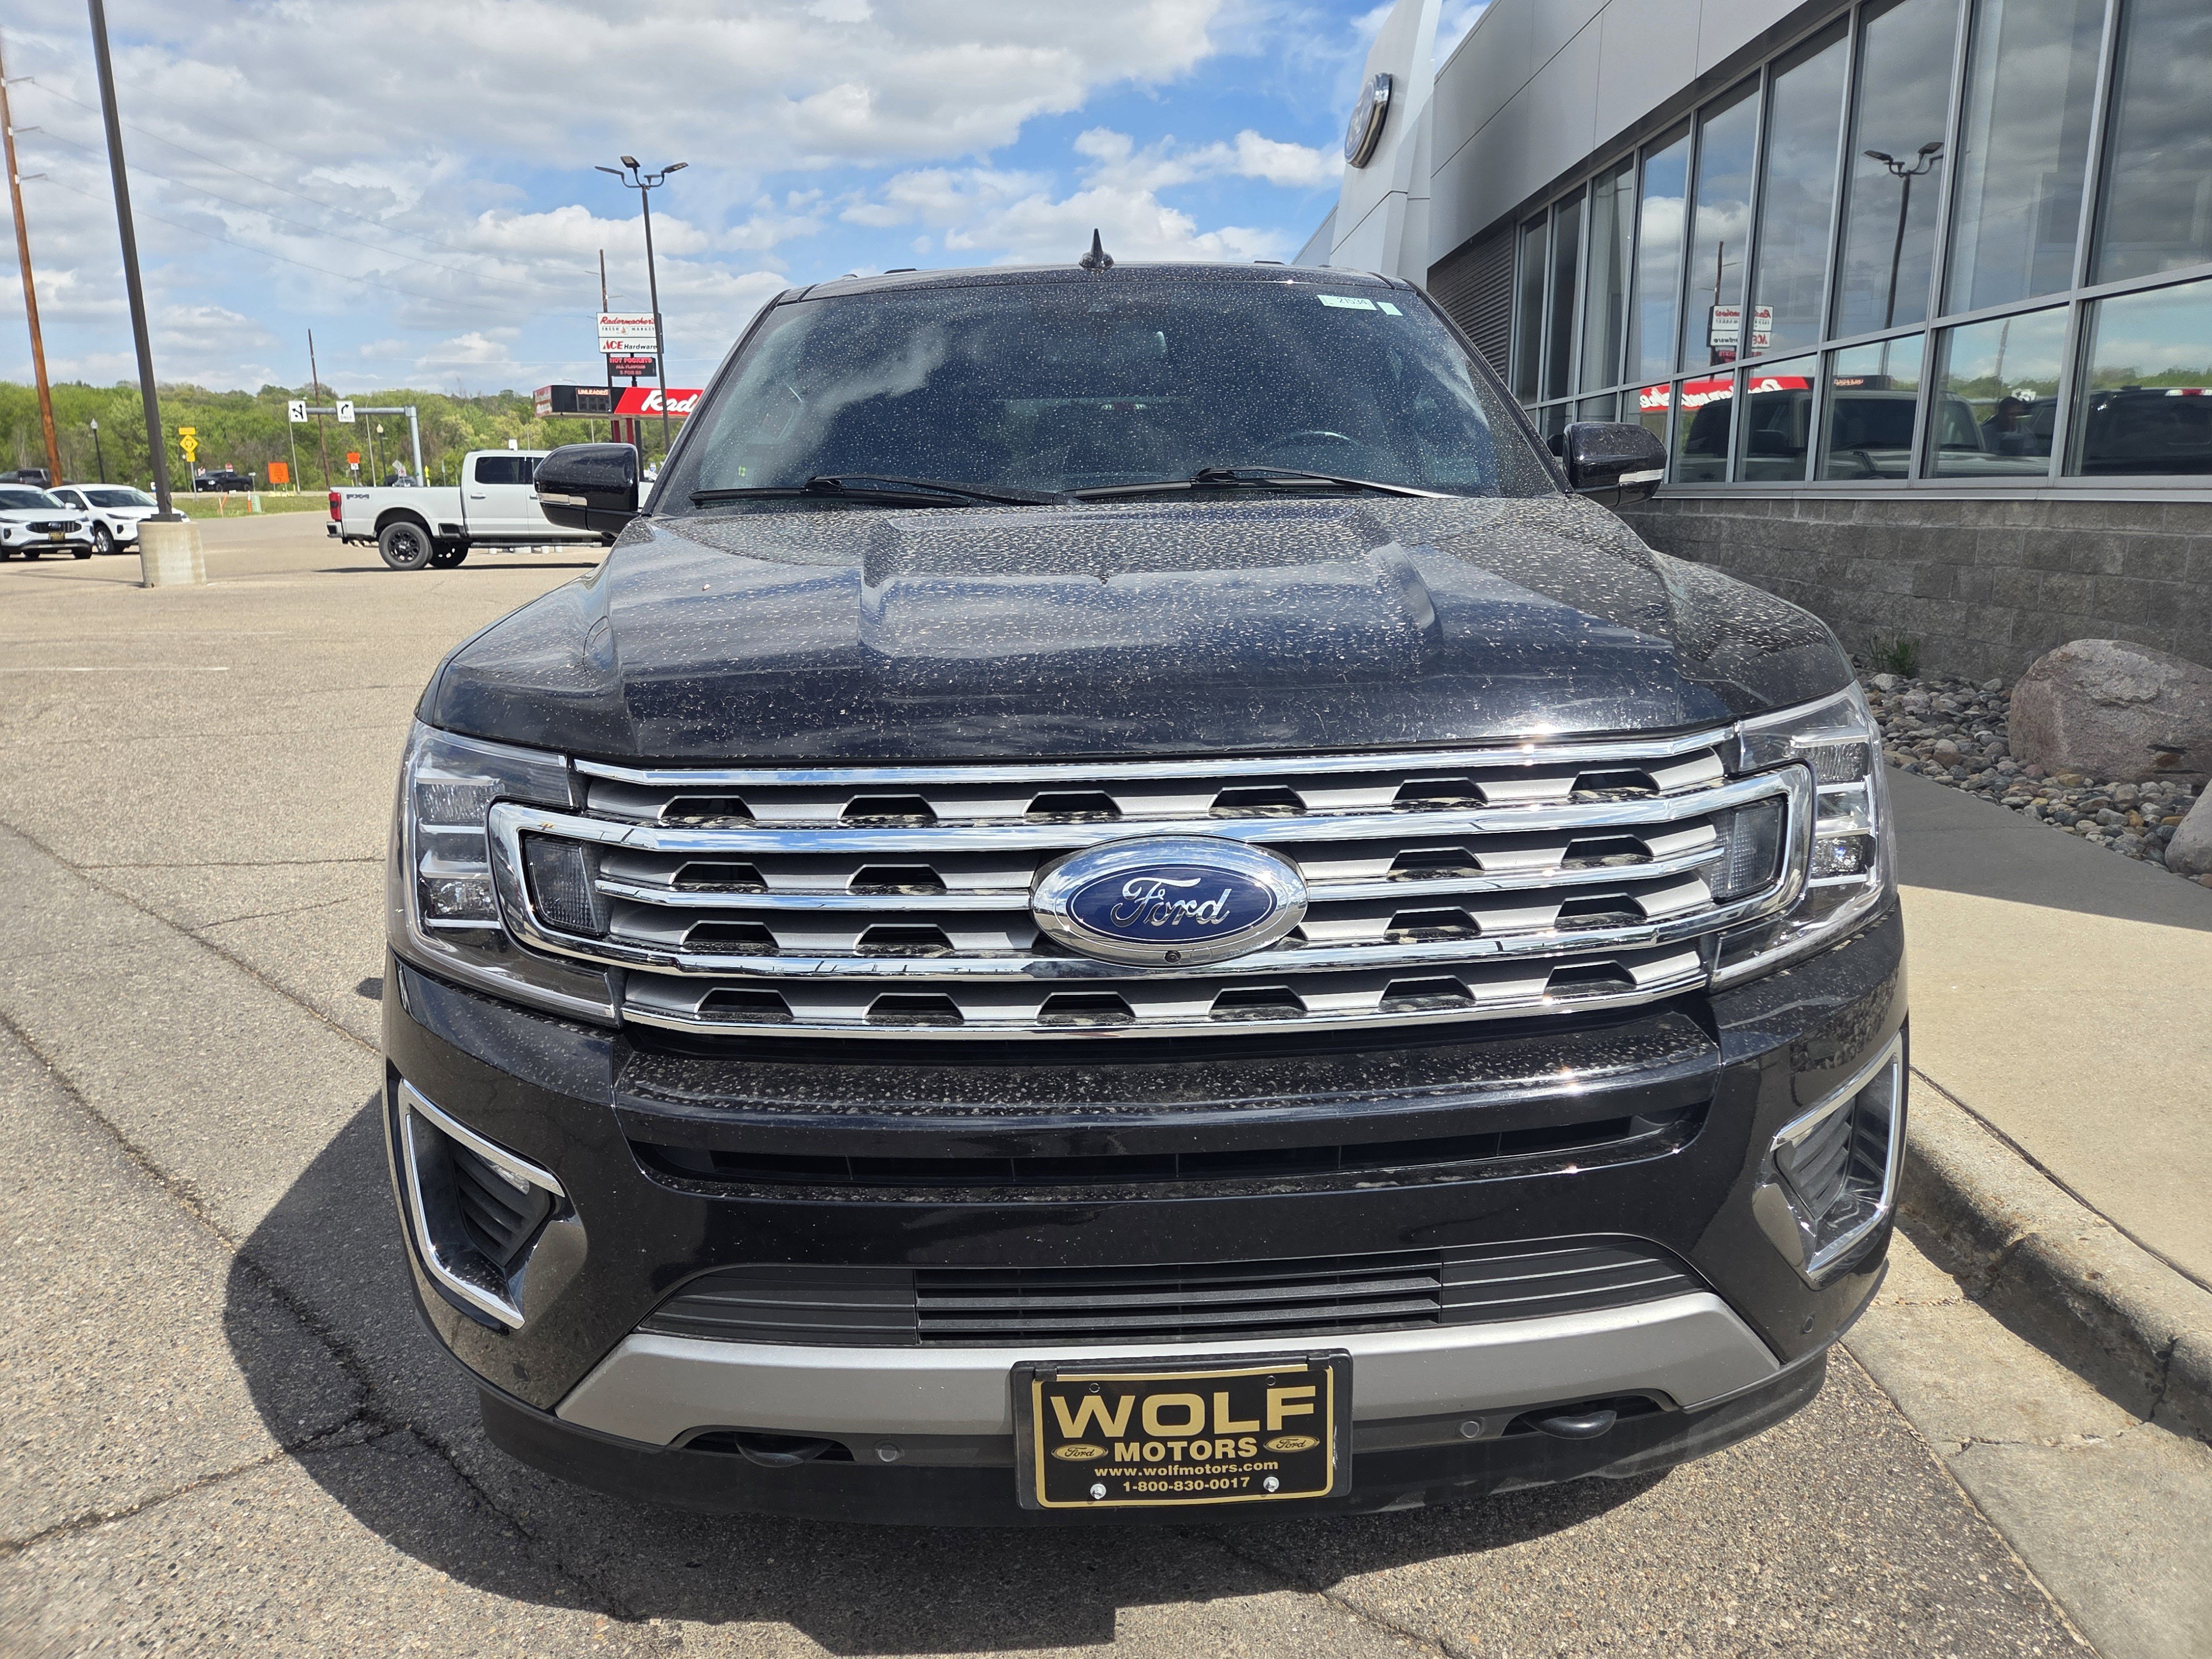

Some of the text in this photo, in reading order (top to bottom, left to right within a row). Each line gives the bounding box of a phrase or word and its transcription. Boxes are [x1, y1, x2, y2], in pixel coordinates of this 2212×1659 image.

[602, 340, 623, 349] ACE
[1110, 877, 1233, 928] Ford
[1050, 1386, 1316, 1438] WOLF
[1114, 1437, 1258, 1462] MOTORS
[1276, 1438, 1307, 1449] Ford
[1065, 1447, 1095, 1457] Ford
[1094, 1461, 1279, 1477] www.wolfmotors.com
[1123, 1477, 1250, 1492] 1-800-830-0017
